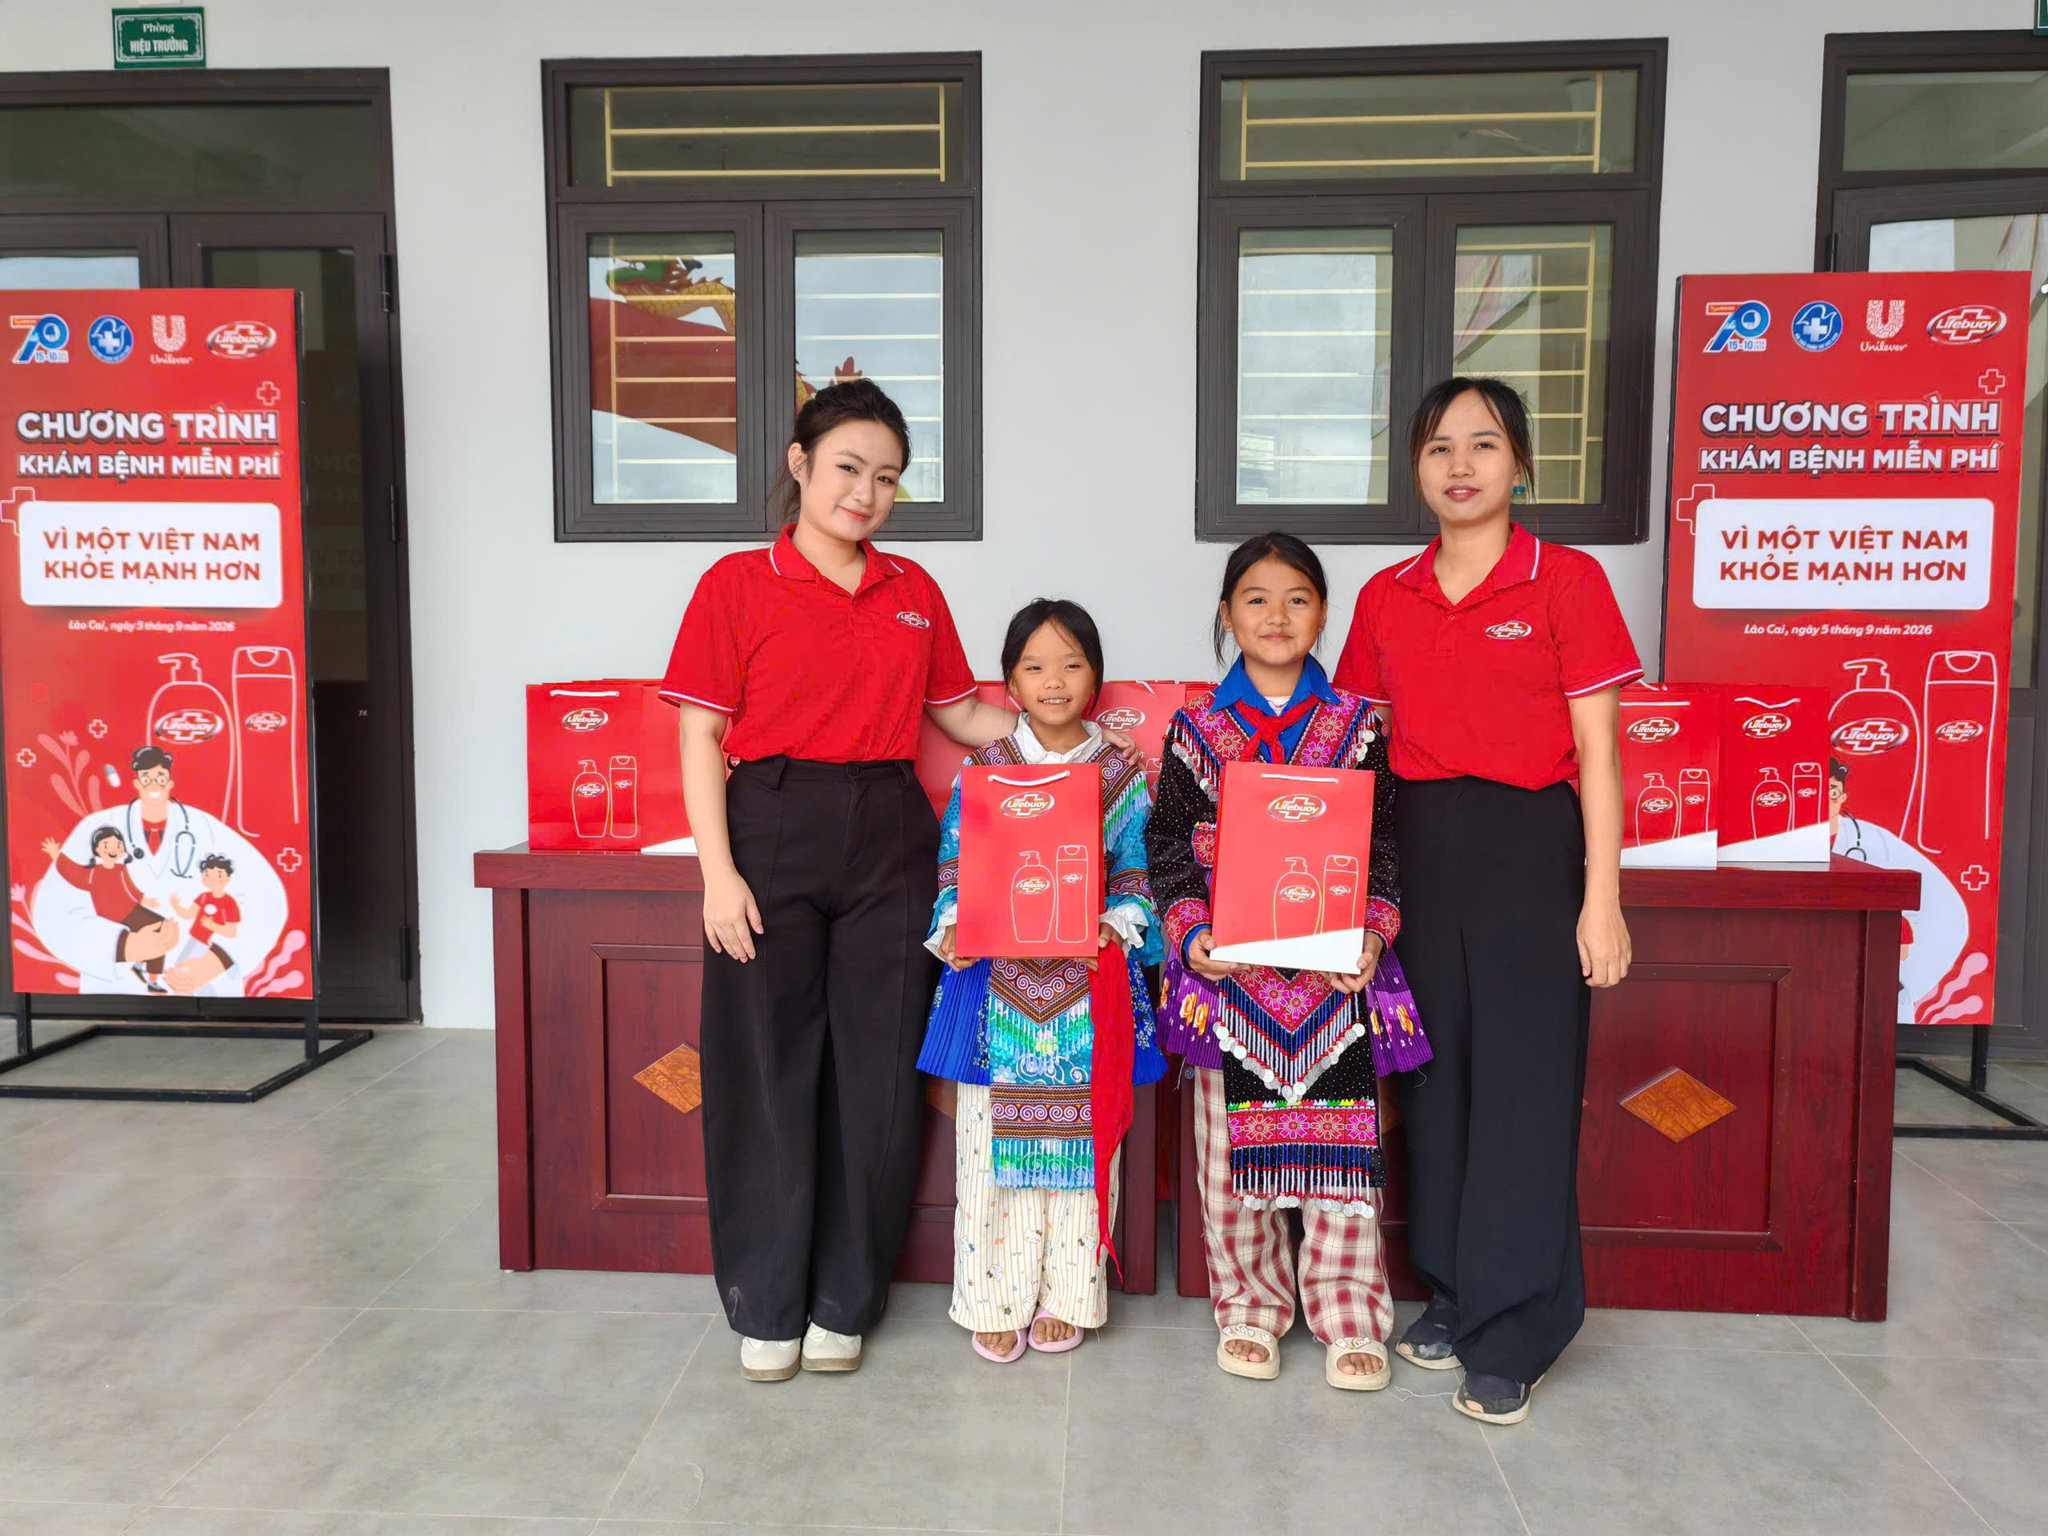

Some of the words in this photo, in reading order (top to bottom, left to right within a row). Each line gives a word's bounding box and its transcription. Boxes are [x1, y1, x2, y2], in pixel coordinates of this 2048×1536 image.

[142, 22, 175, 34] Phòng
[130, 38, 151, 55] HIỆU
[1935, 317, 1996, 334] Lifebuoy
[215, 332, 266, 346] Lifebuoy
[1860, 341, 1908, 353] Unilever
[150, 352, 191, 365] Unilever
[1701, 401, 1868, 433] CHƯƠNG
[1879, 394, 2000, 432] TRÌNH
[17, 411, 165, 440] CHƯƠNG
[174, 404, 278, 440] TRÌNH
[19, 451, 92, 476] KHÁM
[99, 451, 165, 483] BỆNH
[172, 448, 233, 476] MIỄN
[239, 451, 281, 476] PHÍ
[1700, 445, 1781, 471] KHÁM
[1790, 445, 1865, 477] BỆNH
[1873, 440, 1942, 470] MIỄN
[1951, 443, 1999, 470] PHÍ
[43, 526, 70, 551] VÌ
[77, 527, 131, 555] MỘT
[139, 527, 195, 555] VIỆT
[203, 532, 260, 551] NAM
[1721, 525, 1748, 549] VÌ
[1757, 525, 1820, 555] MỘT
[1829, 525, 1893, 555] VIỆT
[1902, 530, 1968, 549] NAM
[44, 554, 115, 579] KHỎE
[122, 561, 197, 585] MẠNH
[206, 559, 261, 581] HƠN
[1720, 554, 1798, 581] KHỎE
[1808, 561, 1893, 586] MẠNH
[1903, 558, 1966, 581] HƠN
[68, 619, 87, 630] Lào
[88, 620, 108, 632] Cai,
[110, 621, 136, 633] ngày
[145, 621, 174, 633] tháng
[175, 621, 183, 632] 9
[184, 621, 207, 631] năm
[208, 621, 236, 631] 2026
[1744, 624, 1764, 635] Lào
[1766, 624, 1789, 636] Cai,
[1791, 625, 1820, 637] ngày
[1821, 624, 1829, 635] 5
[1830, 624, 1863, 637] tháng
[1865, 624, 1874, 635] 9
[1875, 624, 1901, 635] năm
[1902, 625, 1933, 635] 2026
[160, 720, 214, 732] Lifebuoy
[567, 715, 602, 725] Lifebuoy
[1100, 714, 1139, 725] Lifebuoy
[1748, 719, 1785, 731] Lifebuoy
[1633, 724, 1673, 736] Lifebuoy
[1840, 730, 1900, 744] Lifebuoy
[1940, 727, 1977, 737] Lifebuoy
[1006, 798, 1047, 811] Lifebuoy
[1275, 802, 1320, 815] Lifebuoy
